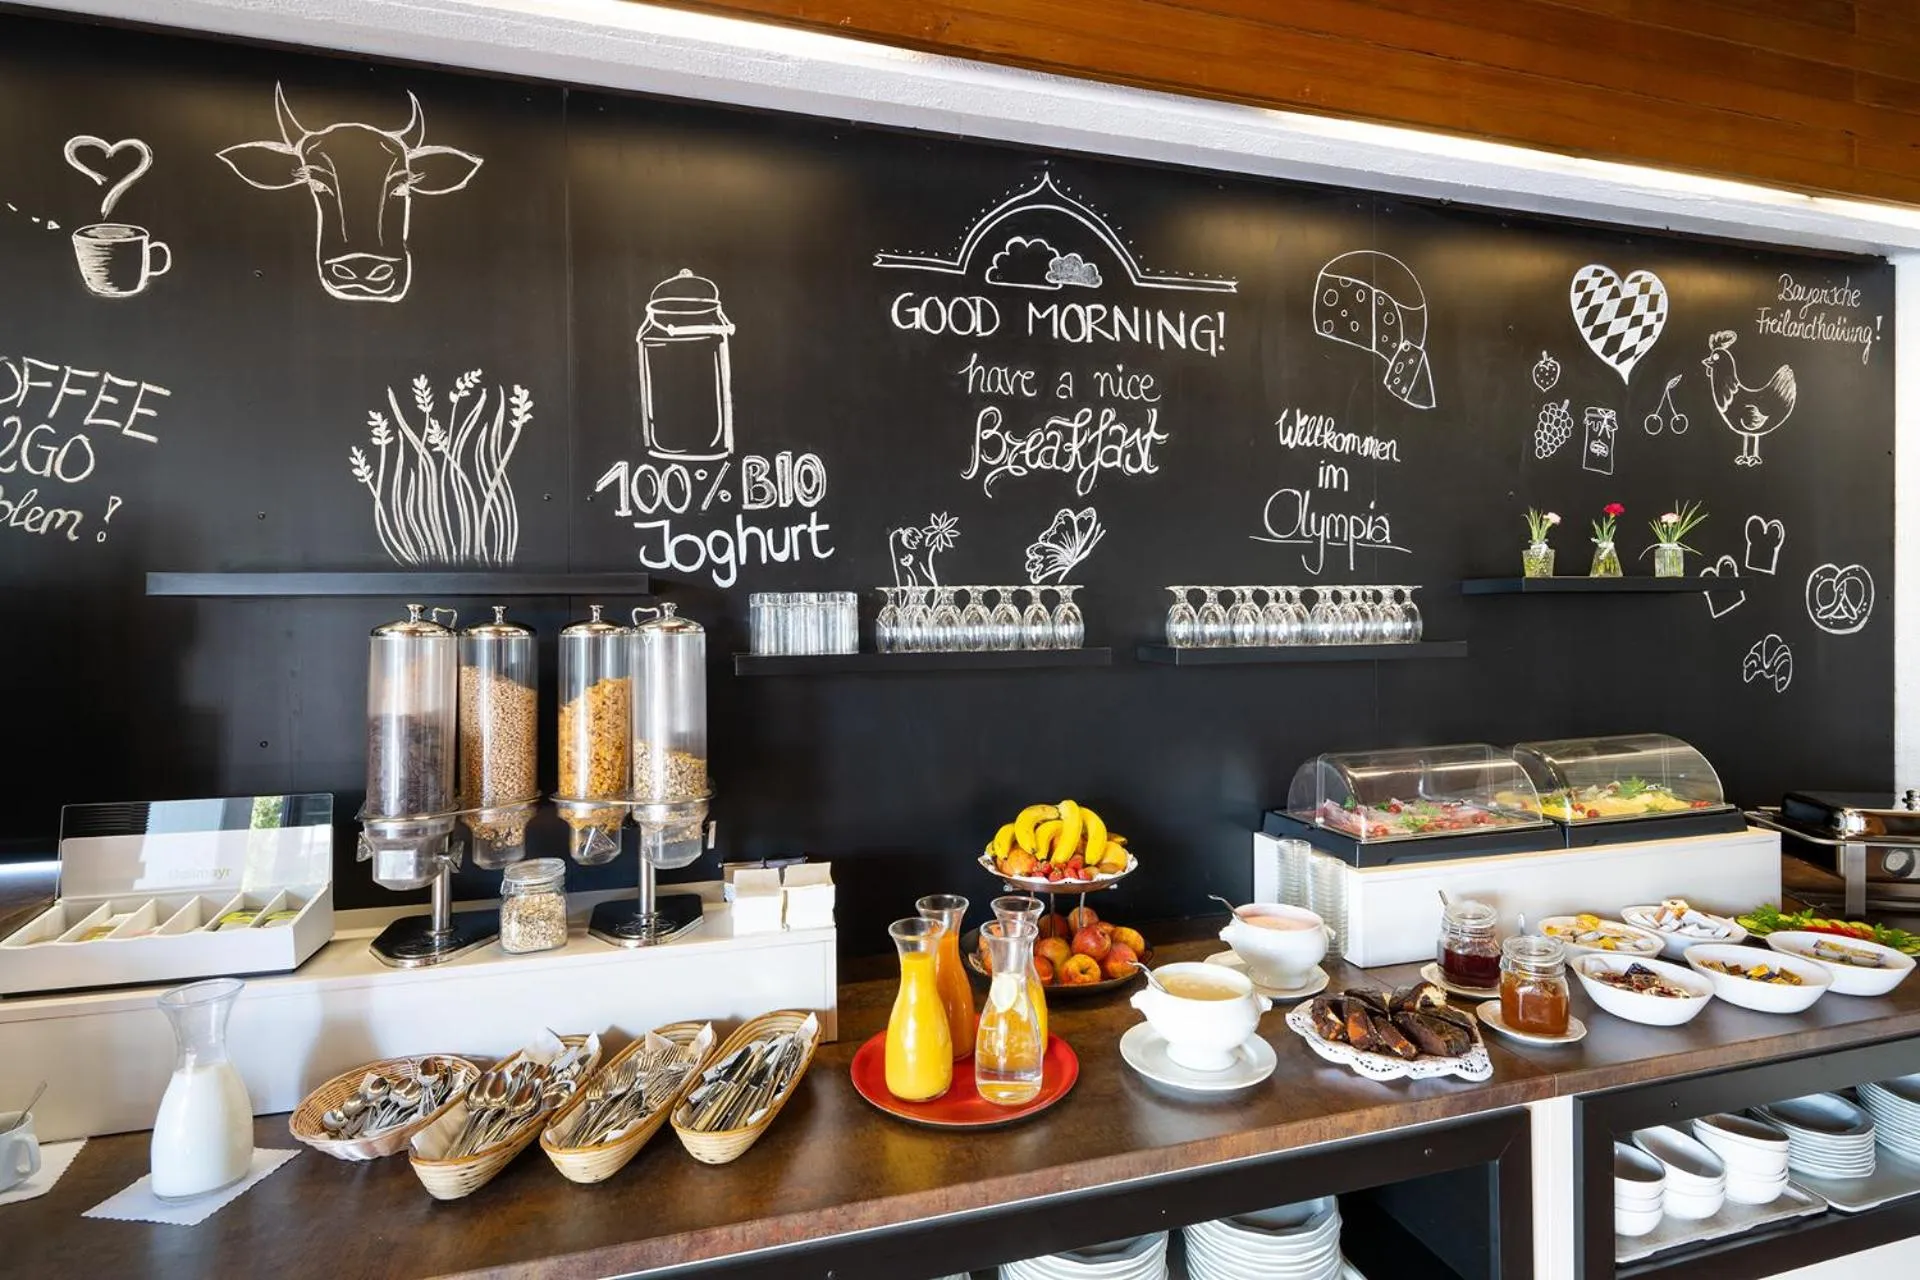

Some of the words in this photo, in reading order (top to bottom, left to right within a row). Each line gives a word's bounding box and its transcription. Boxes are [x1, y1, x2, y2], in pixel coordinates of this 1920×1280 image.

[891, 292, 1000, 337] GOOD
[1028, 302, 1225, 357] MORNING!
[959, 352, 1037, 397] have
[1055, 371, 1073, 400] a
[1093, 363, 1162, 402] nice
[960, 405, 1170, 498] Breakfast
[1275, 408, 1401, 463] Willkommen
[742, 451, 827, 510] BIO
[1317, 460, 1349, 492] im
[633, 511, 835, 588] Joghurt
[1264, 488, 1392, 575] Olympia
